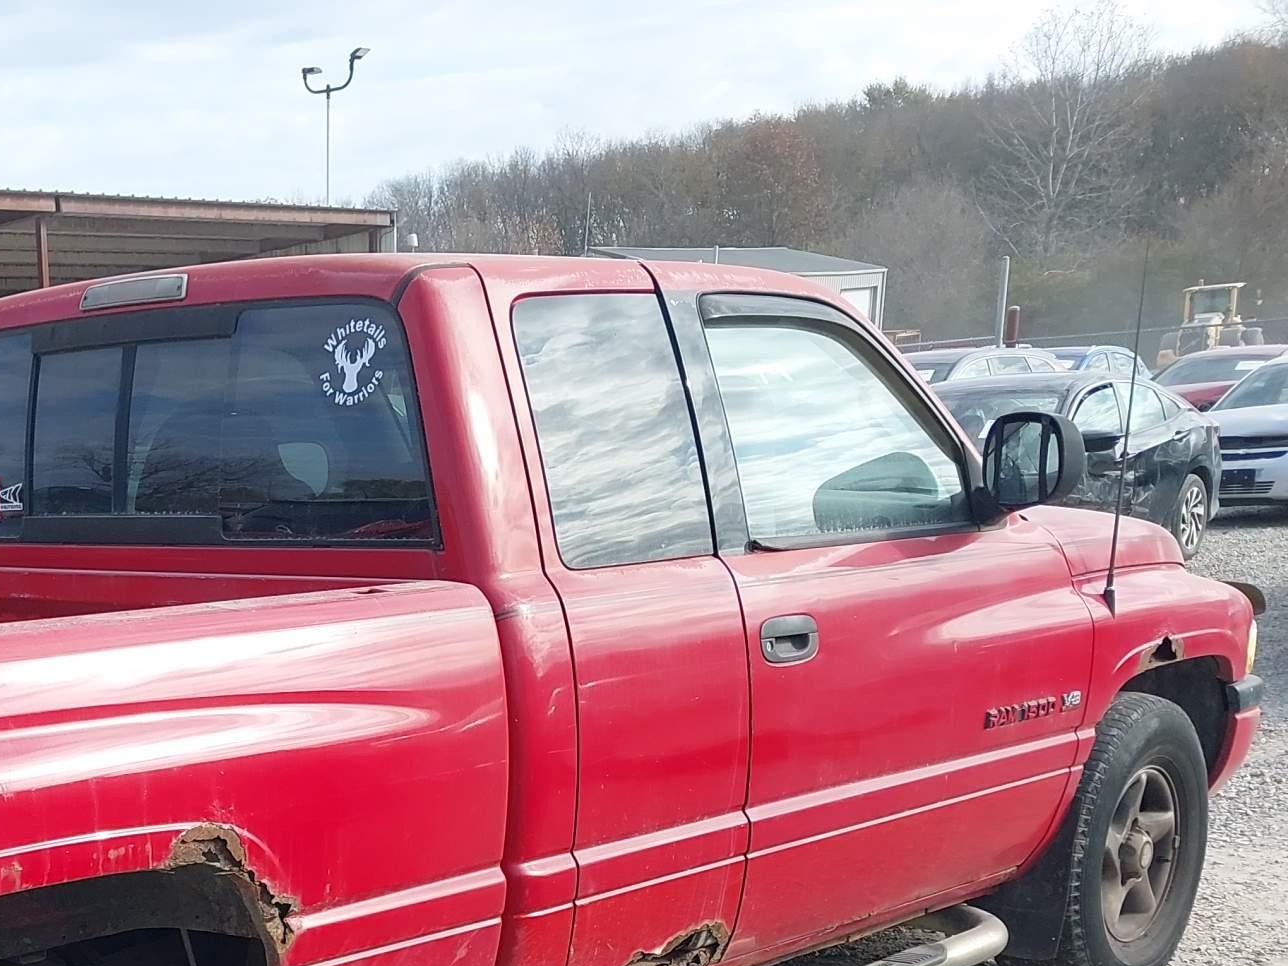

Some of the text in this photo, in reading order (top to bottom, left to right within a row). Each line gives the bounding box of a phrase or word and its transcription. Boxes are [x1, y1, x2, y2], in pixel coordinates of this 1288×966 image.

[323, 318, 387, 353] Whitetails
[319, 370, 384, 406] For Warriors
[983, 704, 1019, 731] RAM
